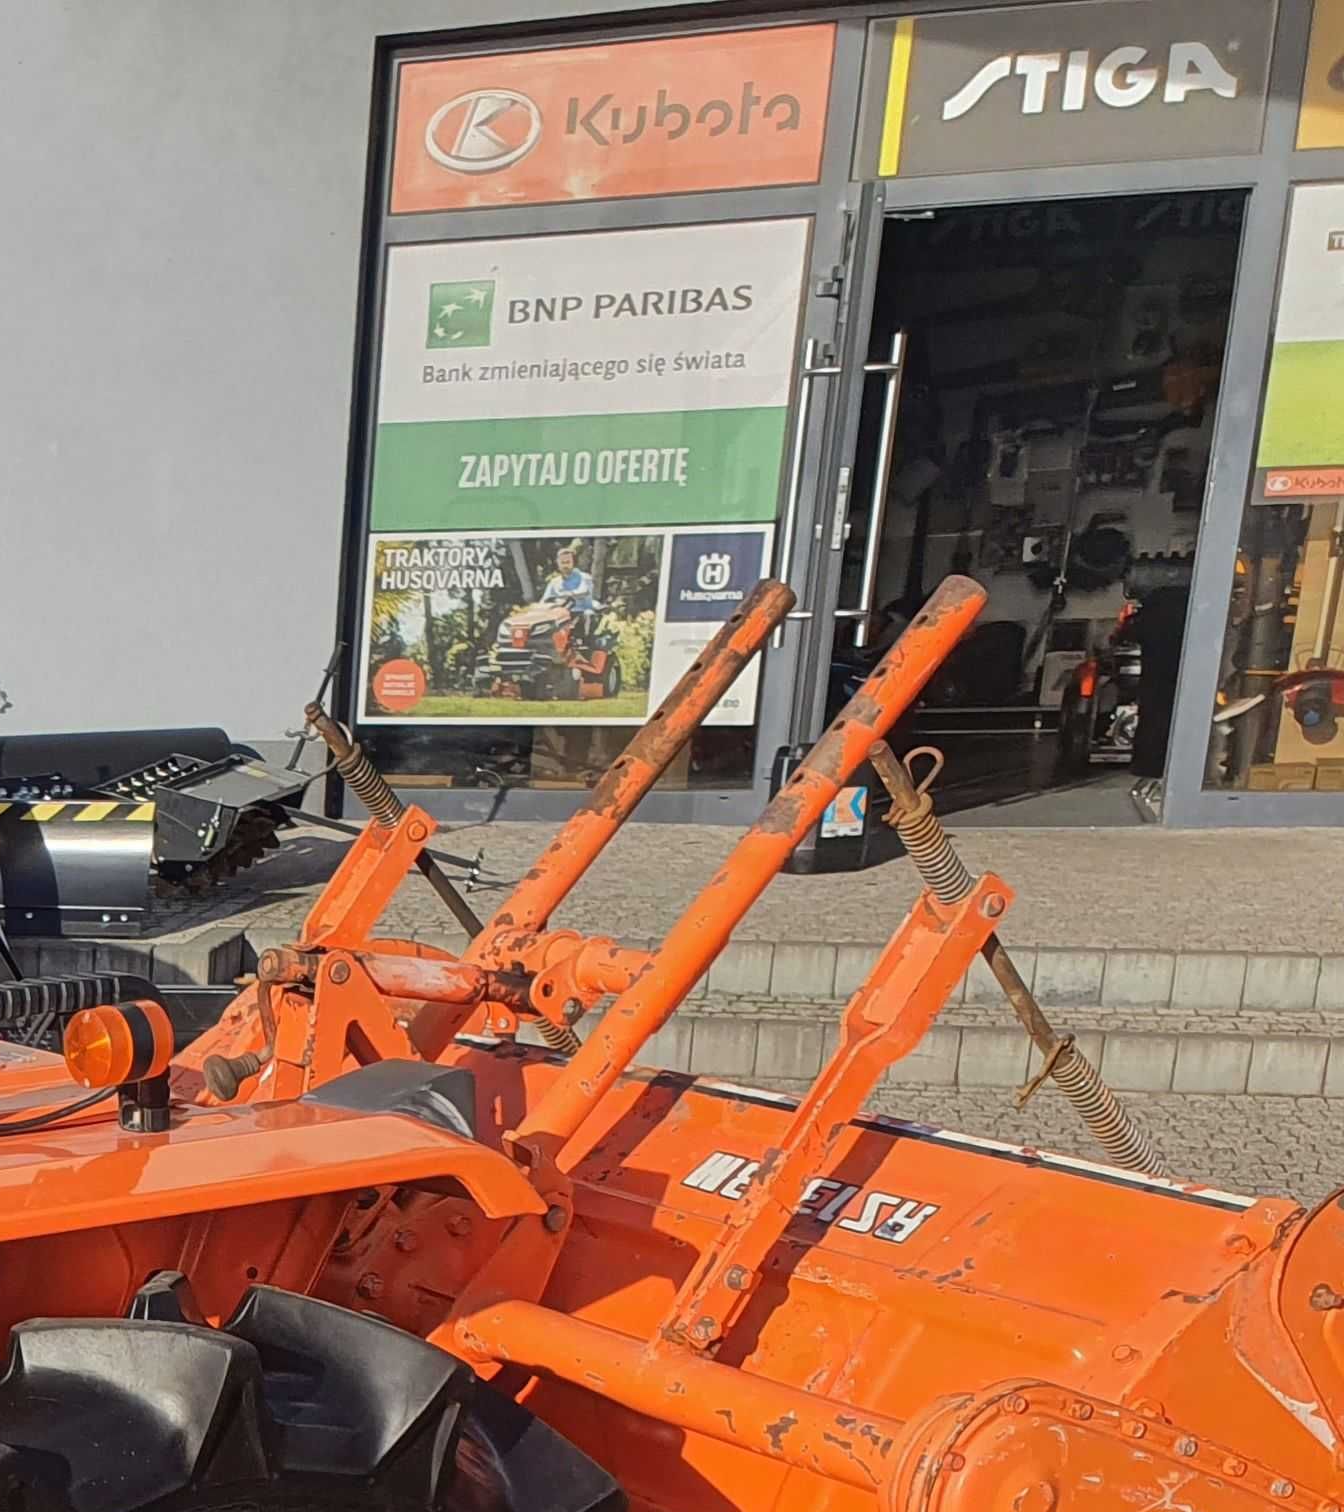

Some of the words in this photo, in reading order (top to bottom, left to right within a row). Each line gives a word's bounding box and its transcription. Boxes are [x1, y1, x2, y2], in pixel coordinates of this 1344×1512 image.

[943, 41, 1238, 121] STIGA
[565, 81, 801, 146] Kubota
[507, 297, 583, 324] BNP
[593, 285, 753, 319] PARIBAS
[422, 363, 473, 384] Bank
[478, 357, 629, 382] zmieniającego
[635, 353, 666, 377] się
[673, 350, 746, 372] świata
[458, 451, 568, 488] ZAPYTAJ
[574, 450, 591, 485] O
[596, 448, 689, 487] OFERTĘ
[382, 548, 489, 568] TRAKTORY
[381, 569, 504, 590] HUSQVARNA
[680, 588, 743, 602] Husqvarna
